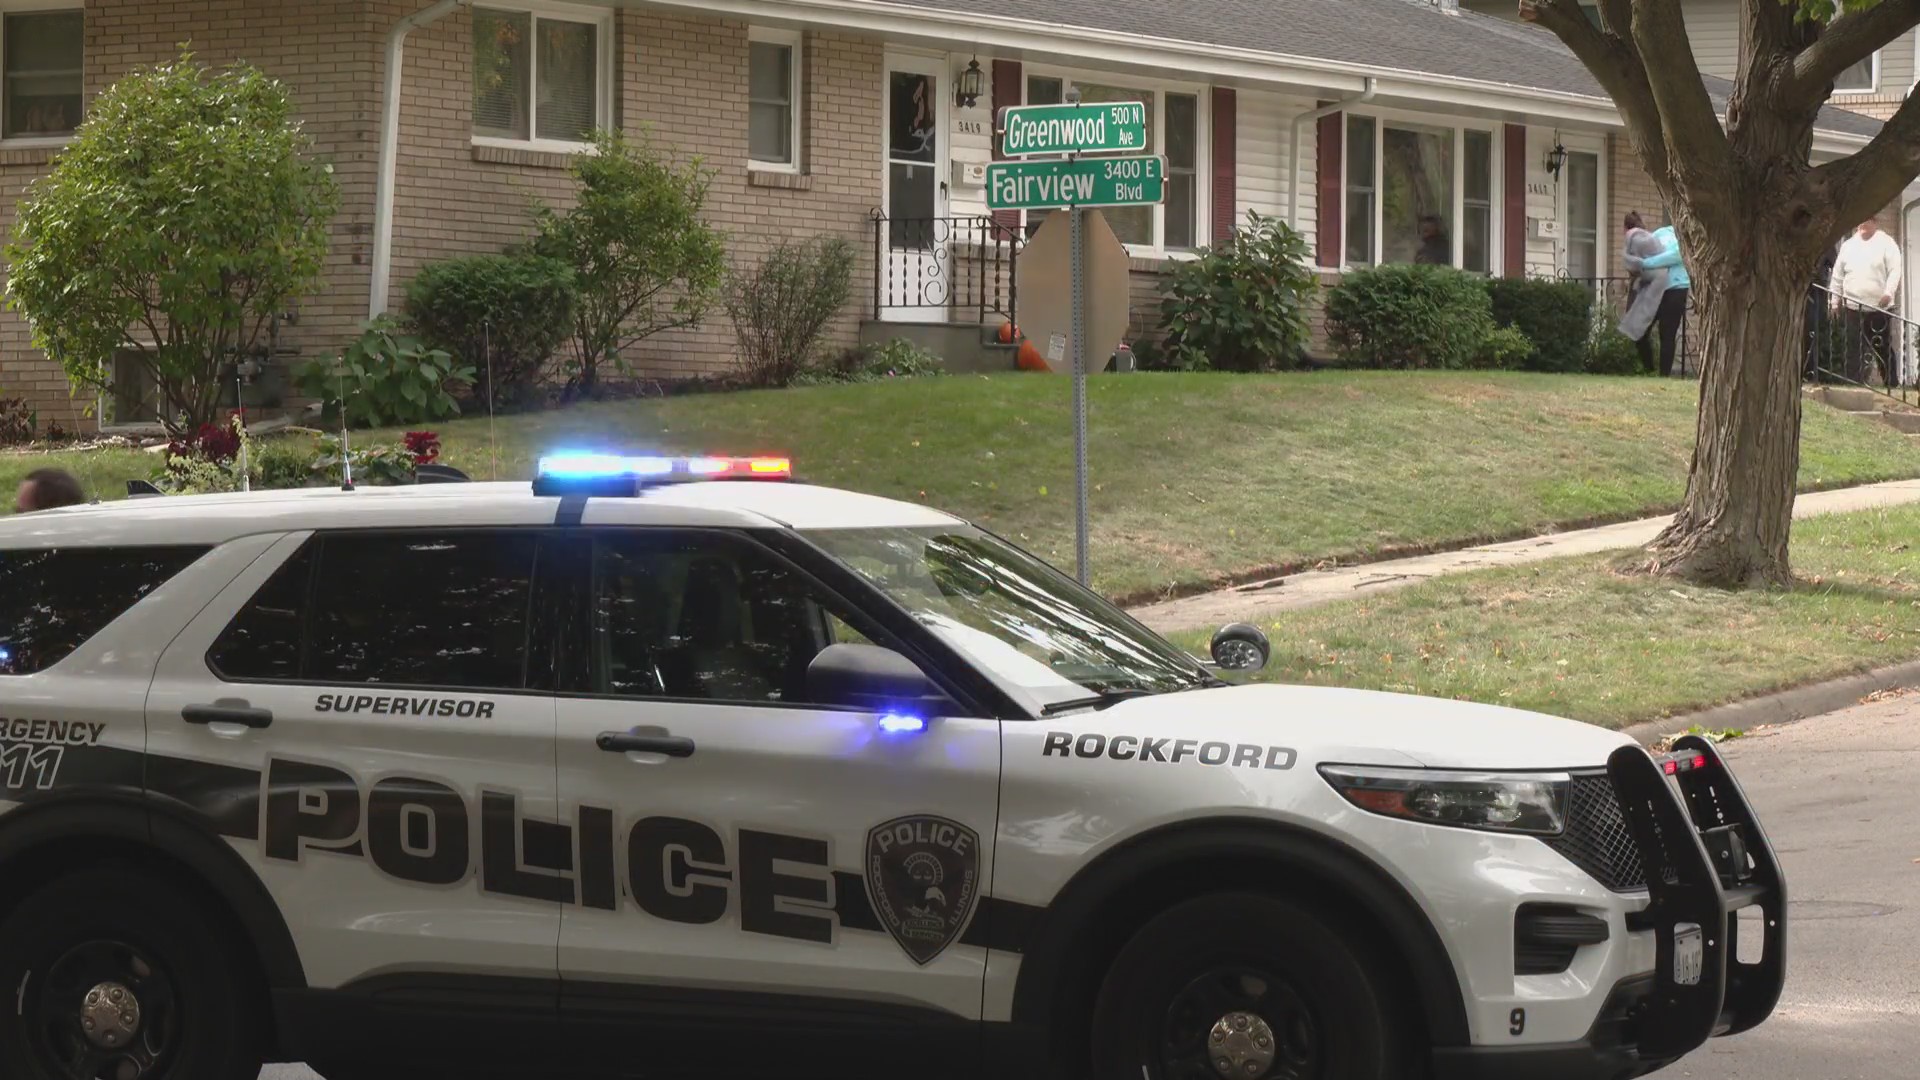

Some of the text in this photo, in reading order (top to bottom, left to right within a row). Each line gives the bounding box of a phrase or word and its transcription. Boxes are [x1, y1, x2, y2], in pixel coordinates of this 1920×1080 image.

[958, 121, 981, 134] 3419
[1009, 112, 1105, 149] Greenwood
[1111, 106, 1140, 125] 500 N
[1118, 128, 1133, 145] Ave
[992, 166, 1095, 204] Fairview
[1104, 160, 1154, 180] 3400 E
[1115, 183, 1142, 201] Blvd
[314, 694, 495, 719] SUPERVISOR
[0, 743, 64, 790] 11
[1042, 731, 1298, 771] ROCKFORD
[263, 757, 836, 946] POLICE
[875, 822, 973, 857] POLICE
[872, 855, 900, 928] ROCKFORD
[949, 870, 973, 926] ILLINOIS
[1509, 1007, 1526, 1036] 9
